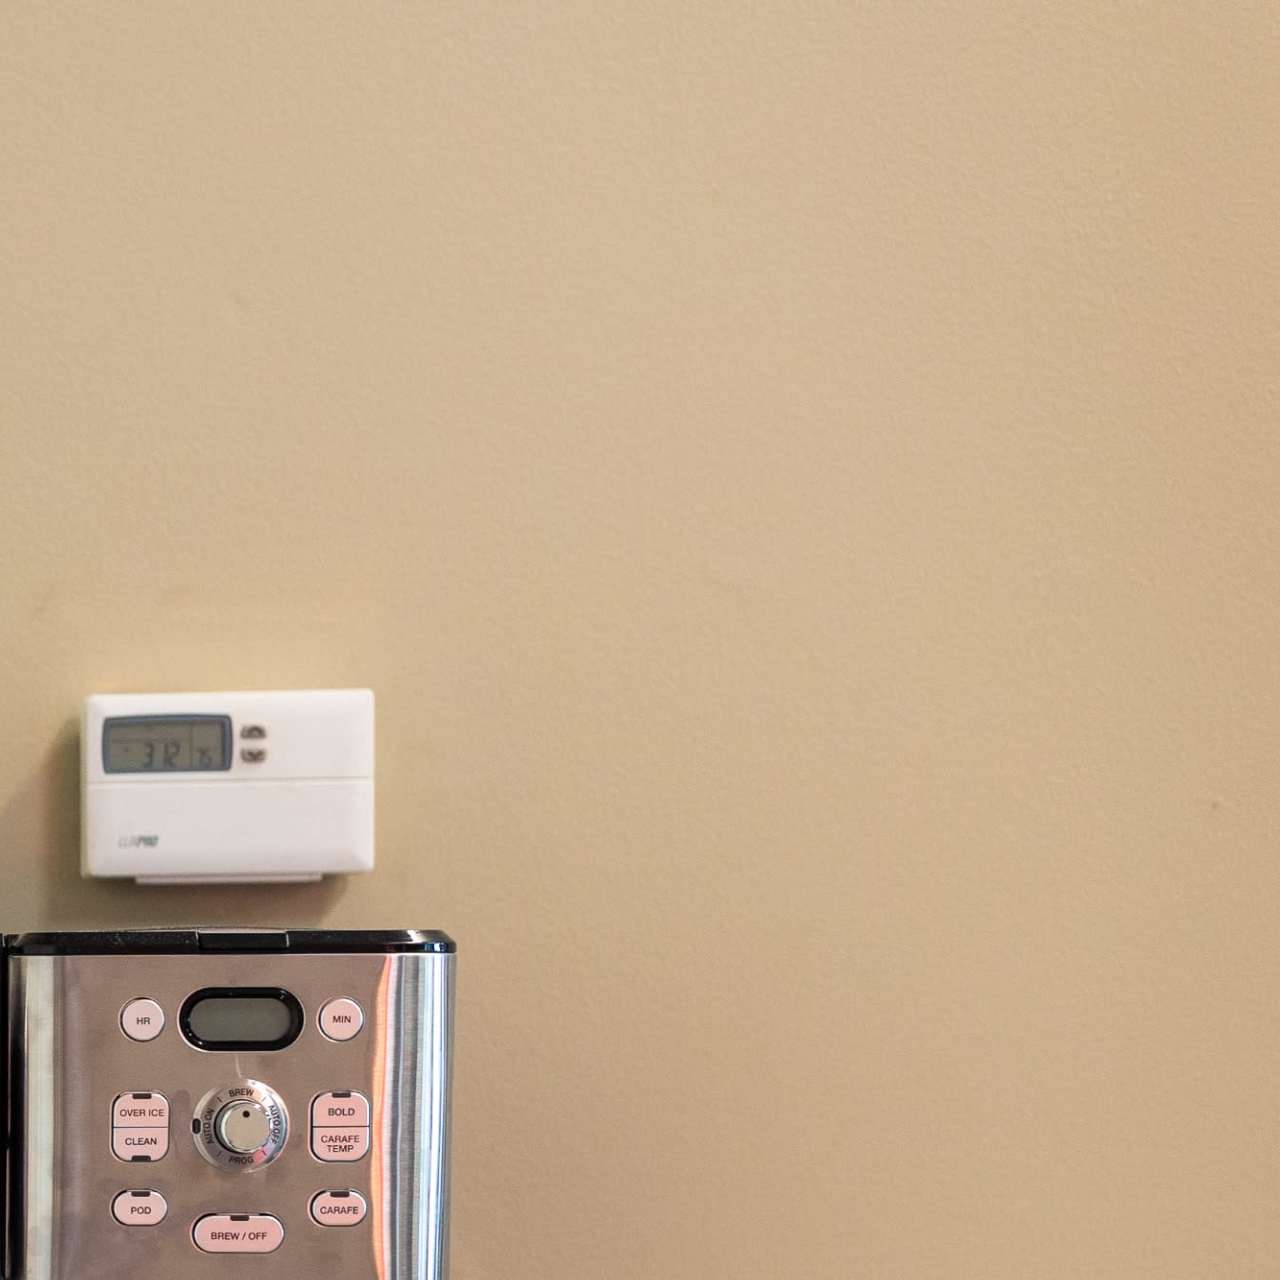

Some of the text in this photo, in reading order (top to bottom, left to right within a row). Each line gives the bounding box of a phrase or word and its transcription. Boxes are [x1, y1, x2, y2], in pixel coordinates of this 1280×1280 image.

[136, 1016, 151, 1026] HR
[332, 1014, 352, 1024] MIN
[228, 1087, 255, 1097] BREW
[119, 1108, 165, 1118] OVER ICE
[327, 1107, 355, 1117] BOLD
[202, 1107, 215, 1144] AUTO ON
[268, 1105, 281, 1145] AUTO OFF
[124, 1137, 158, 1146] CLEAN
[320, 1134, 360, 1144] CARAFE
[326, 1144, 354, 1153] TEMP
[228, 1155, 255, 1165] PROG
[130, 1206, 152, 1215] POD
[319, 1205, 359, 1215] CARAFE
[210, 1231, 240, 1241] BREW
[248, 1231, 268, 1241] OFF
